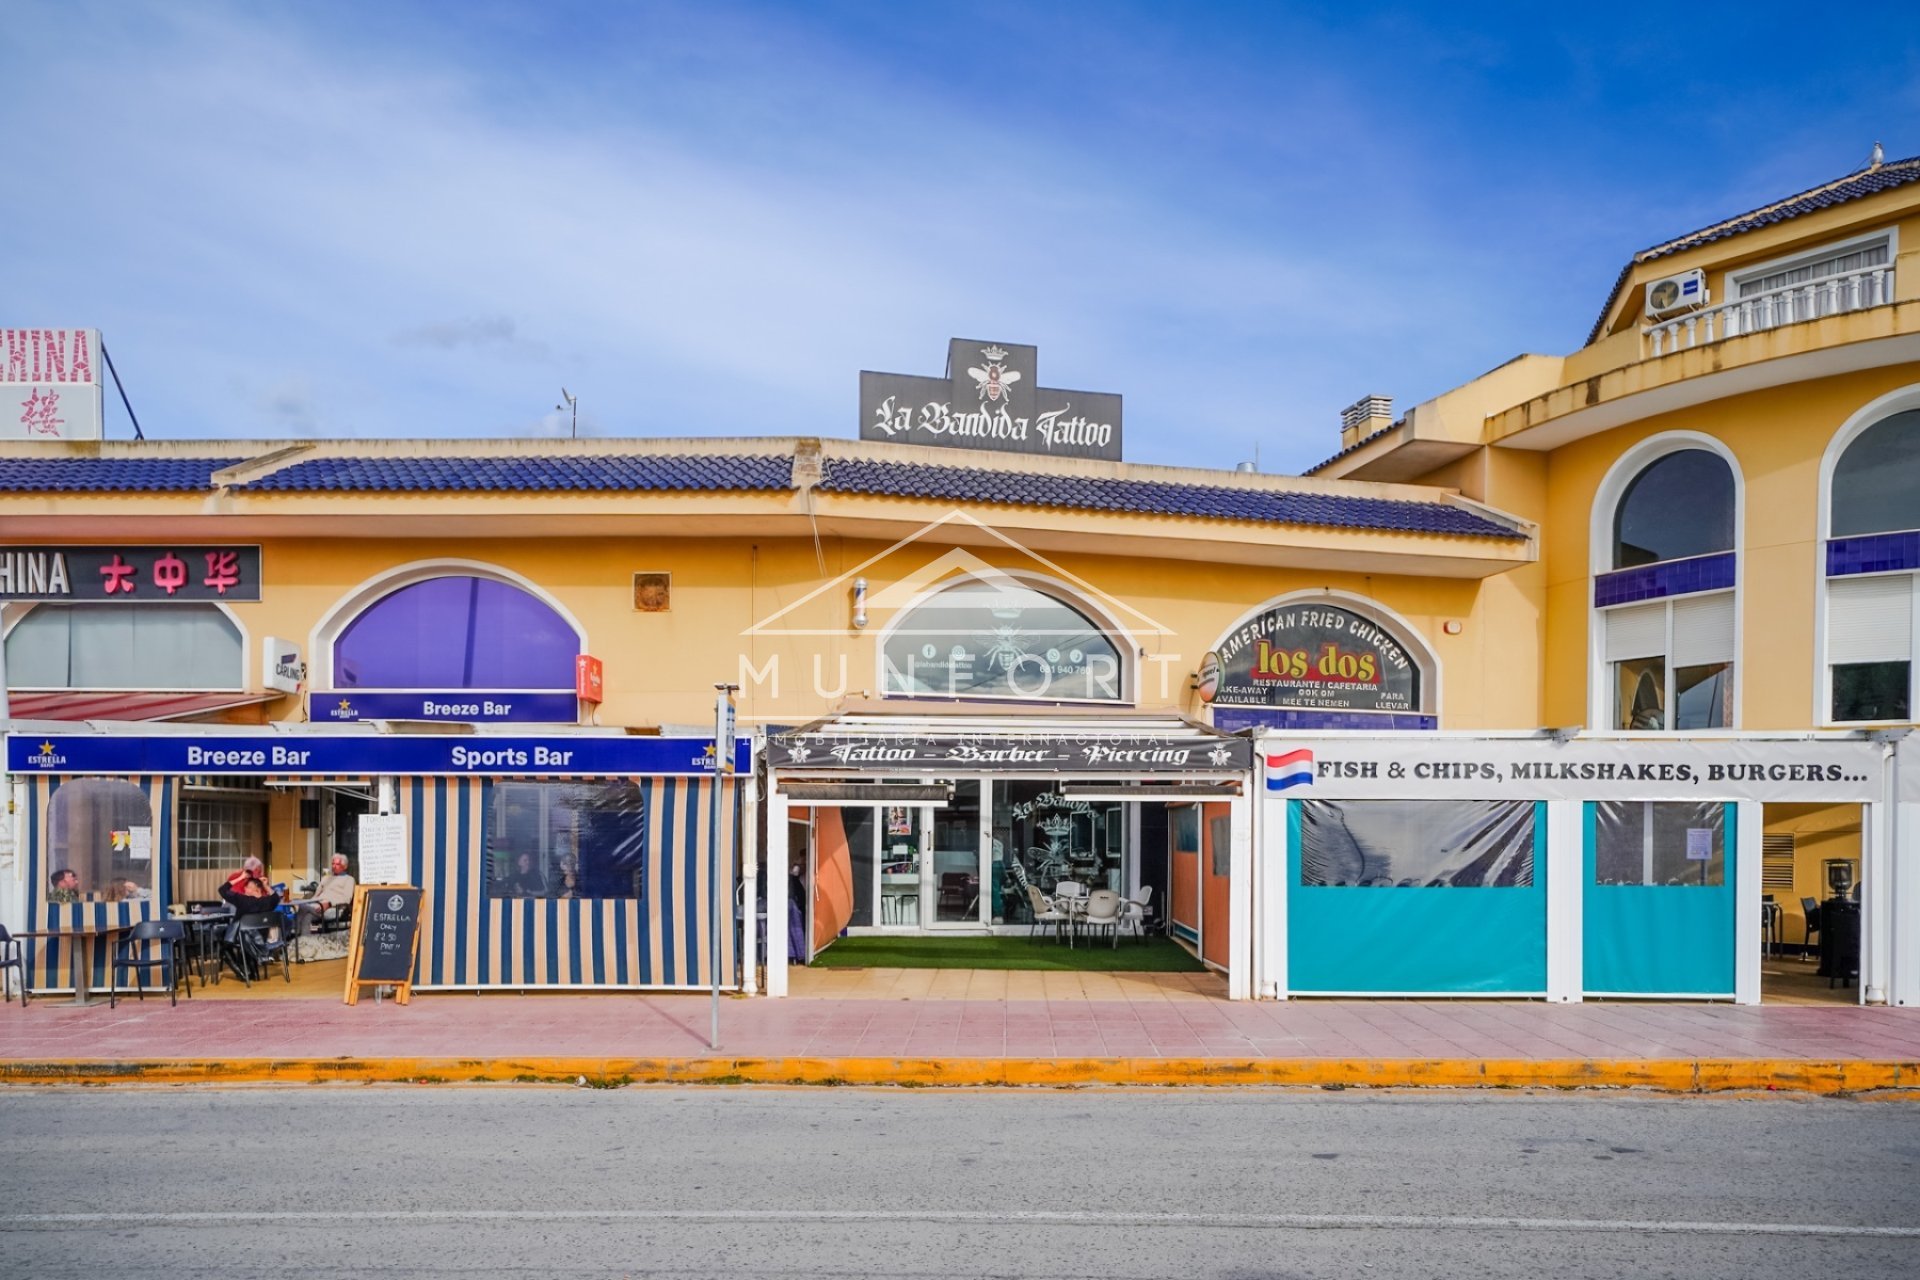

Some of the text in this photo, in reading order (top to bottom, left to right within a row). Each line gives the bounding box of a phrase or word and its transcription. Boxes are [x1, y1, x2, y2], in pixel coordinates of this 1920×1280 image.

[0, 330, 92, 382] HINA
[872, 395, 1112, 450] La Bandida Tattoo
[1222, 611, 1409, 669] AMERICAN FRIED CHICKEN
[1258, 641, 1375, 682] los dos
[1219, 686, 1268, 696] AKE-AWAY
[1252, 679, 1320, 689] RESTAURANTE
[1327, 681, 1378, 692] CAFETARIA
[1299, 689, 1335, 698] OOK OM
[1380, 692, 1404, 701] PARA
[1215, 695, 1267, 705] AVAILABLE
[1282, 697, 1350, 708] MEE TE NEMEN
[1375, 701, 1409, 711] LLEVAR
[423, 701, 512, 716] Breeze Bar
[28, 755, 67, 764] ESTRELLA
[187, 746, 310, 766] Breeze Bar
[451, 746, 573, 769] Sports Bar
[830, 742, 916, 765] Tattoo
[945, 744, 1051, 764] Barber
[1082, 744, 1190, 767] Piercing
[691, 757, 717, 766] ESTRE
[1317, 761, 1868, 785] FISH & CHIPS, MILKSHAKES, BURGERS...
[373, 912, 411, 921] ESTRELLA
[380, 922, 398, 931] ONLY
